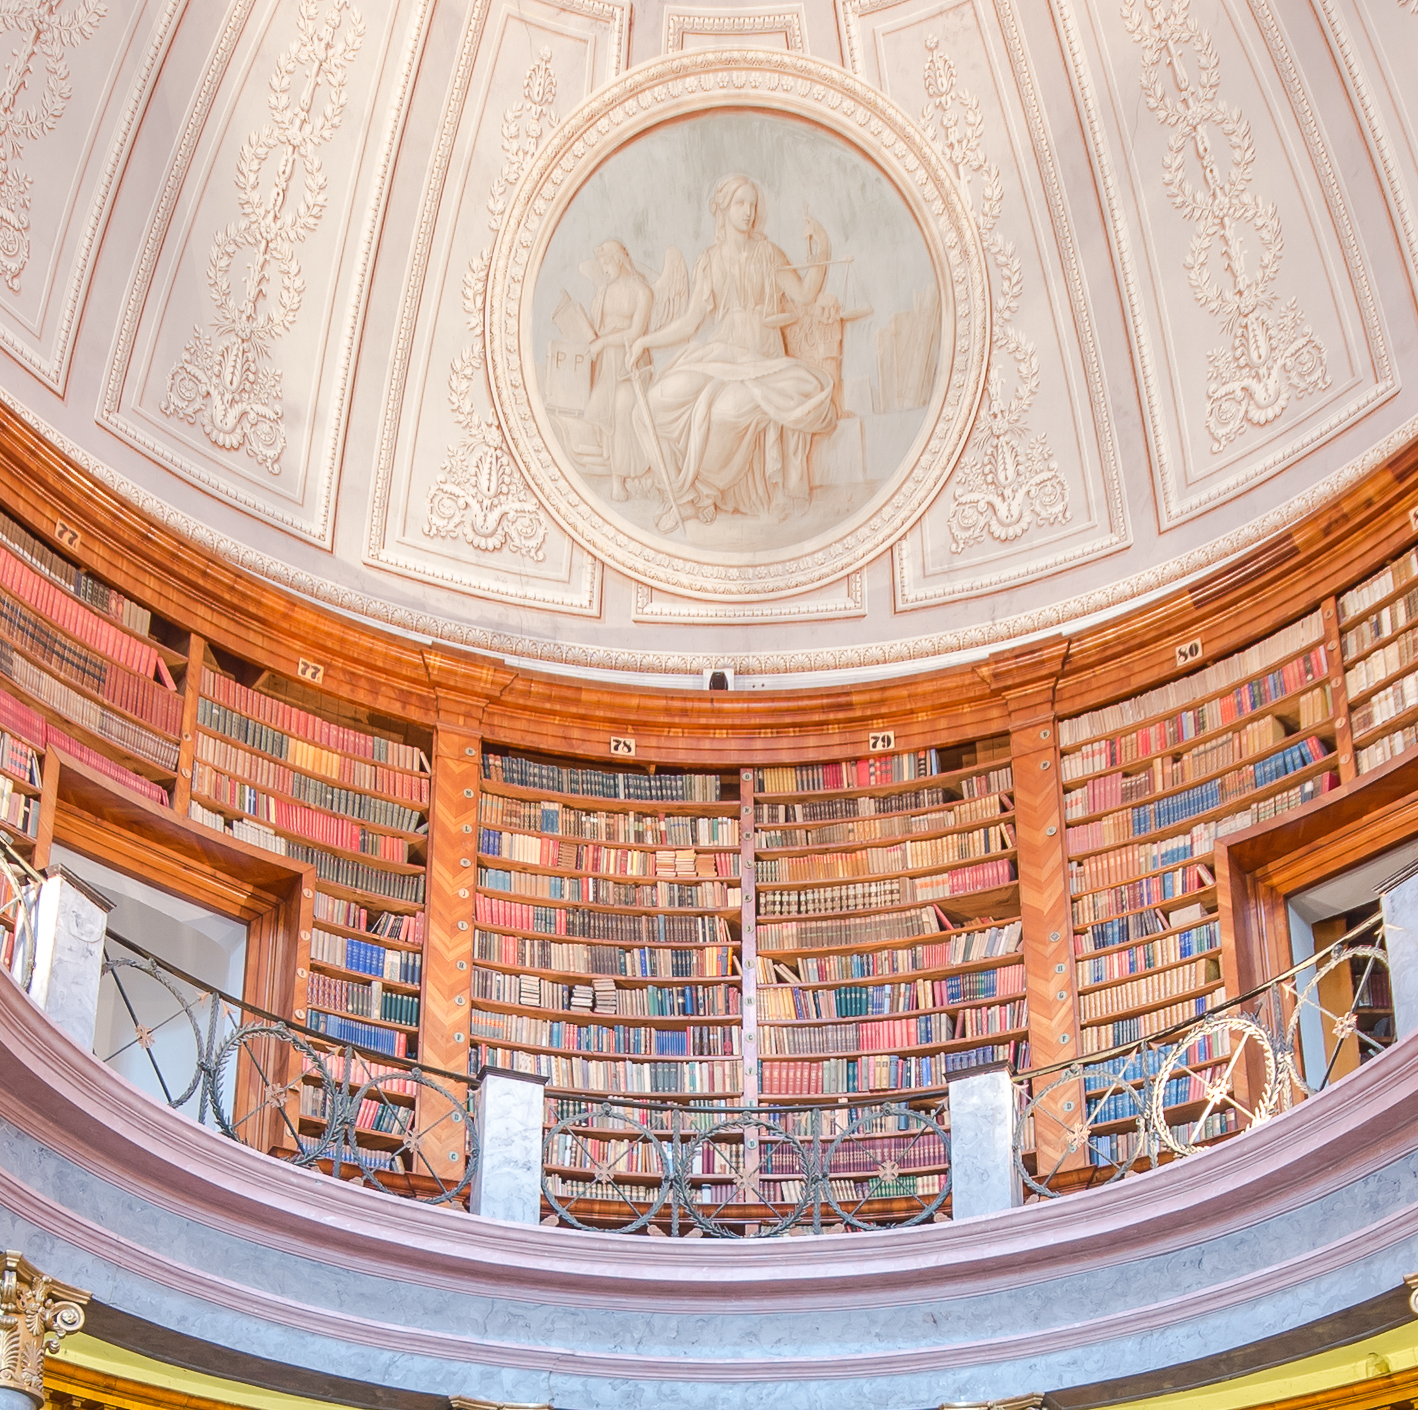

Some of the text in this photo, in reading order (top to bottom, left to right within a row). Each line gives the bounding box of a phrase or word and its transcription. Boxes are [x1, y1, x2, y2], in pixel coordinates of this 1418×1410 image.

[1177, 642, 1199, 663] 80
[612, 738, 632, 753] 78
[870, 734, 892, 749] 79
